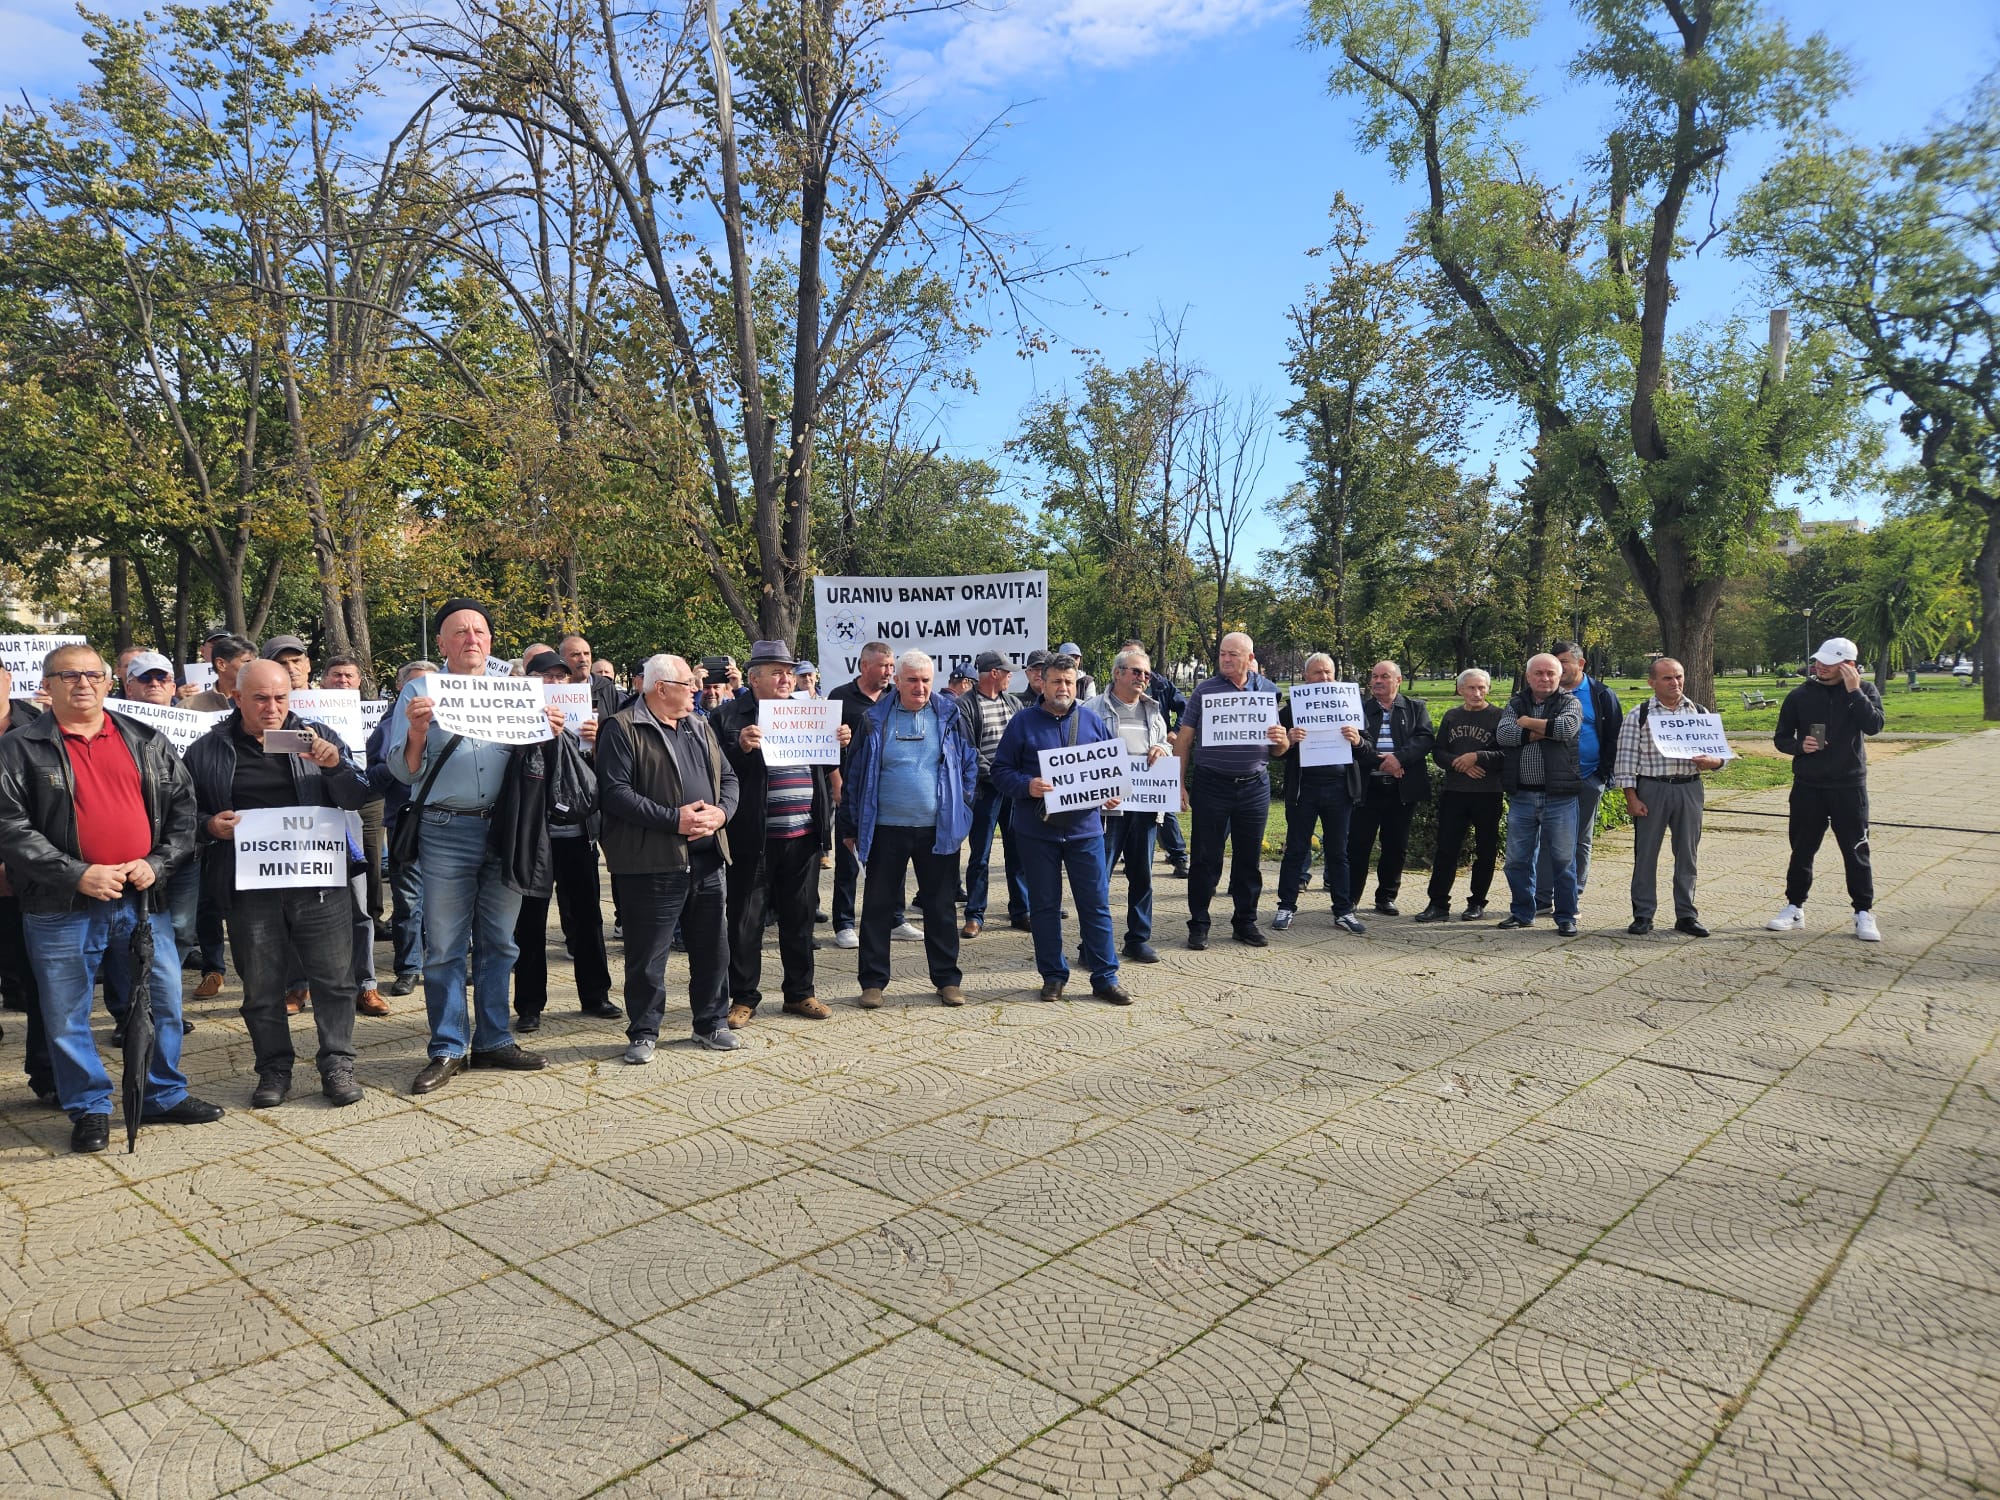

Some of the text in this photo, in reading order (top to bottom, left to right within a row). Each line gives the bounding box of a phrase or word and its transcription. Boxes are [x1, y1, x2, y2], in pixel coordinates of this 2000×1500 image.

[827, 581, 1042, 604] URANIU BANAT ORAVIȚA!
[877, 617, 1029, 639] NOI V-AM VOTAT,
[440, 679, 532, 692] NOI ÎN MINĂ
[1293, 686, 1356, 698] NU FURAȚI
[439, 697, 536, 709] AM LUCRAT
[551, 693, 589, 704] MINERI
[1204, 697, 1274, 709] DREPTATE
[360, 705, 375, 715] NOI
[773, 706, 827, 715] MINERITU
[1305, 700, 1350, 710] PENSIA
[466, 714, 492, 723] DIN
[497, 715, 545, 724] PENSII
[772, 720, 825, 729] NO MURIT
[1212, 713, 1267, 725] PENTRU
[1296, 713, 1361, 725] MINERILOR
[1660, 719, 1713, 728] PSD-PNL
[172, 728, 187, 738] AU
[496, 729, 546, 739] FURAT
[1686, 733, 1720, 741] FURAT
[764, 735, 833, 744] NUMA UN PIC
[1684, 745, 1727, 753] PENSIE
[1049, 746, 1119, 767] CIOLACU
[1131, 762, 1150, 772] NU
[1052, 766, 1123, 787] NU FURA
[1060, 786, 1120, 806] MINERII
[282, 816, 314, 830] NU
[240, 840, 344, 855] DISCRIMINAȚI
[259, 862, 334, 876] MINERII
